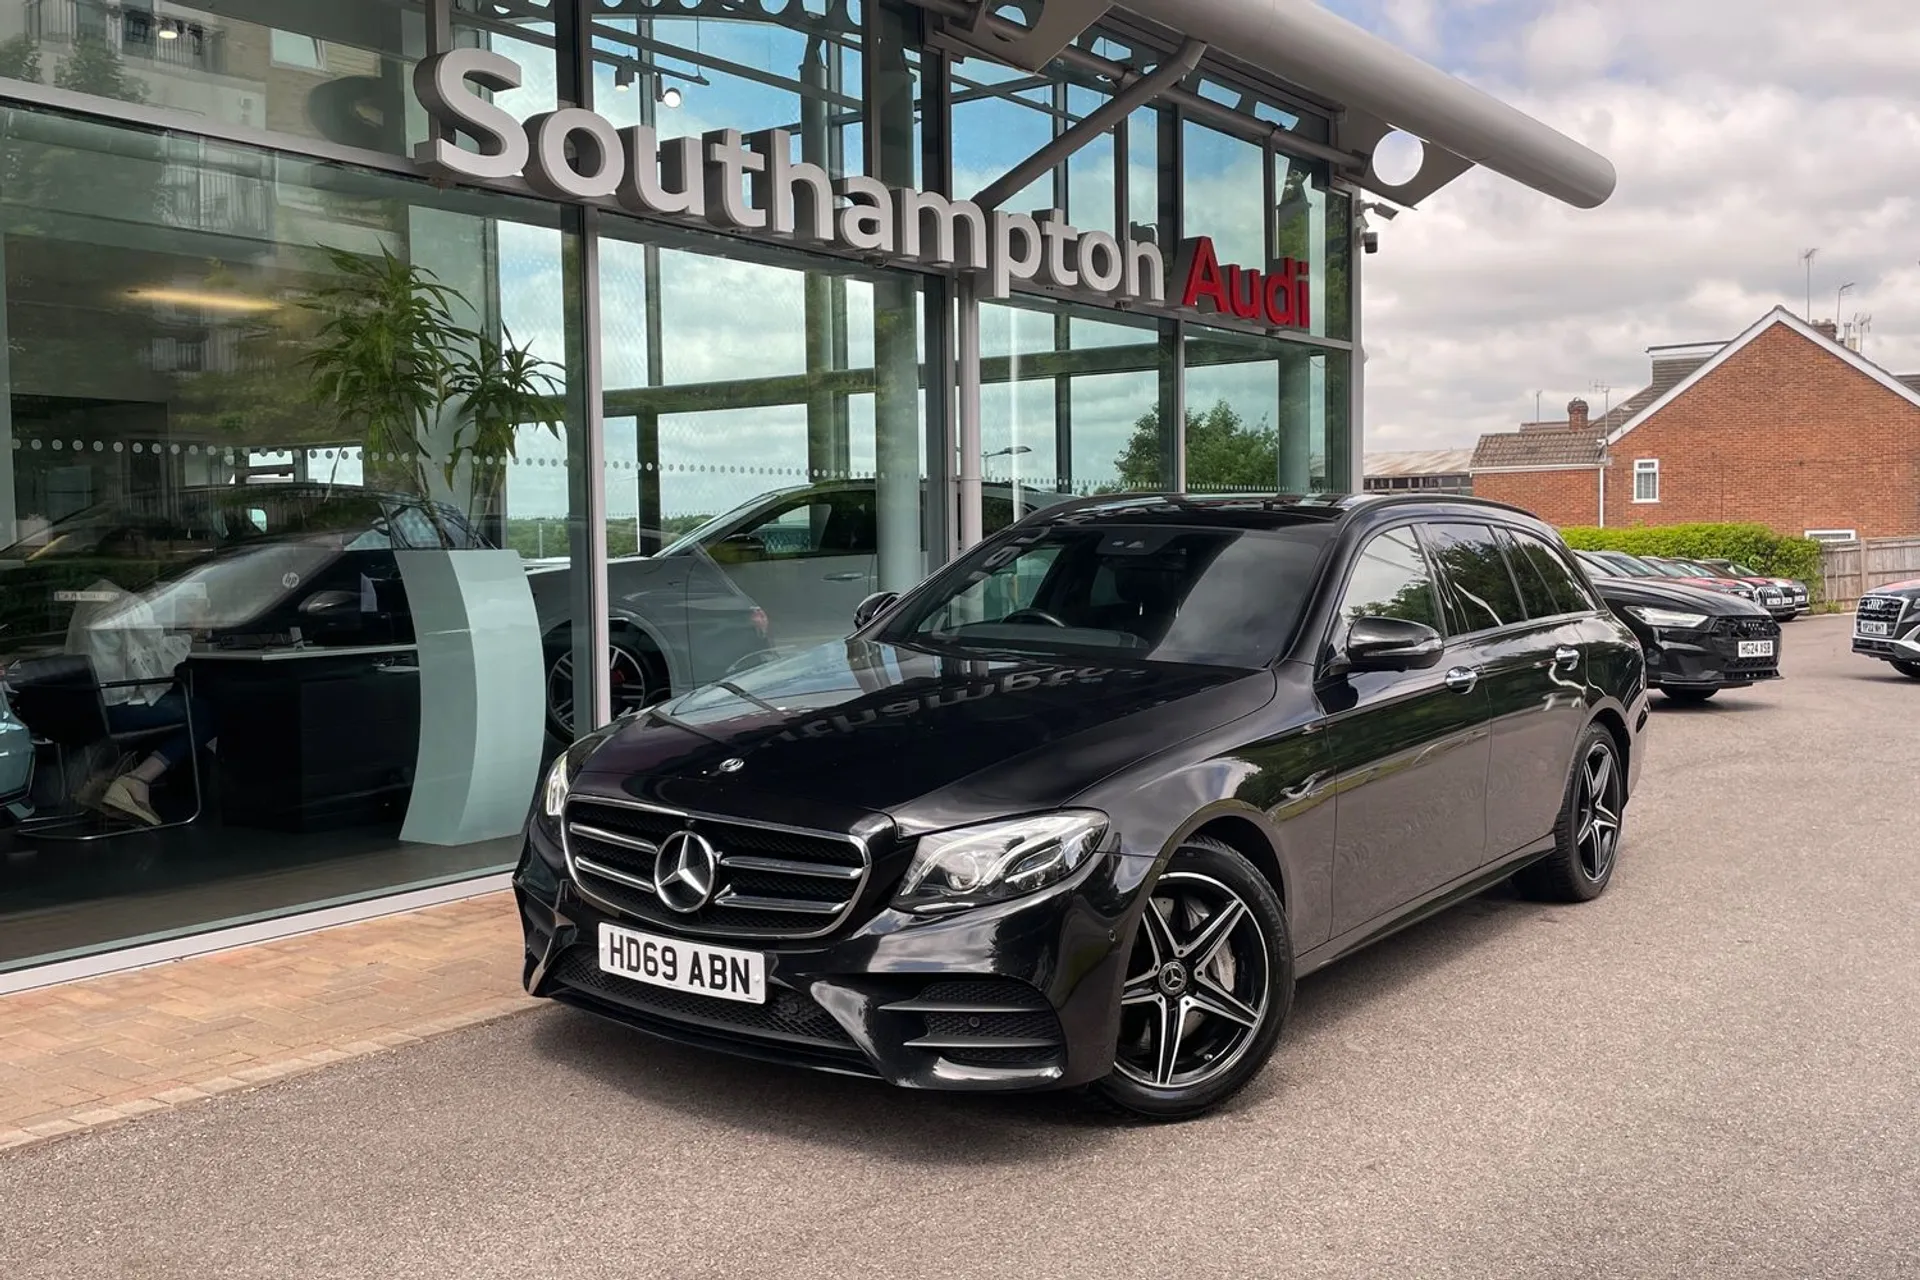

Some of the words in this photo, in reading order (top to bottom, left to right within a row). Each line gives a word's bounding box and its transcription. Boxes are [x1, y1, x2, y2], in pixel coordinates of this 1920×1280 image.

[414, 48, 1165, 300] Southampton
[1180, 236, 1310, 329] Audi
[610, 932, 678, 982] HD69
[688, 951, 751, 995] ABN
